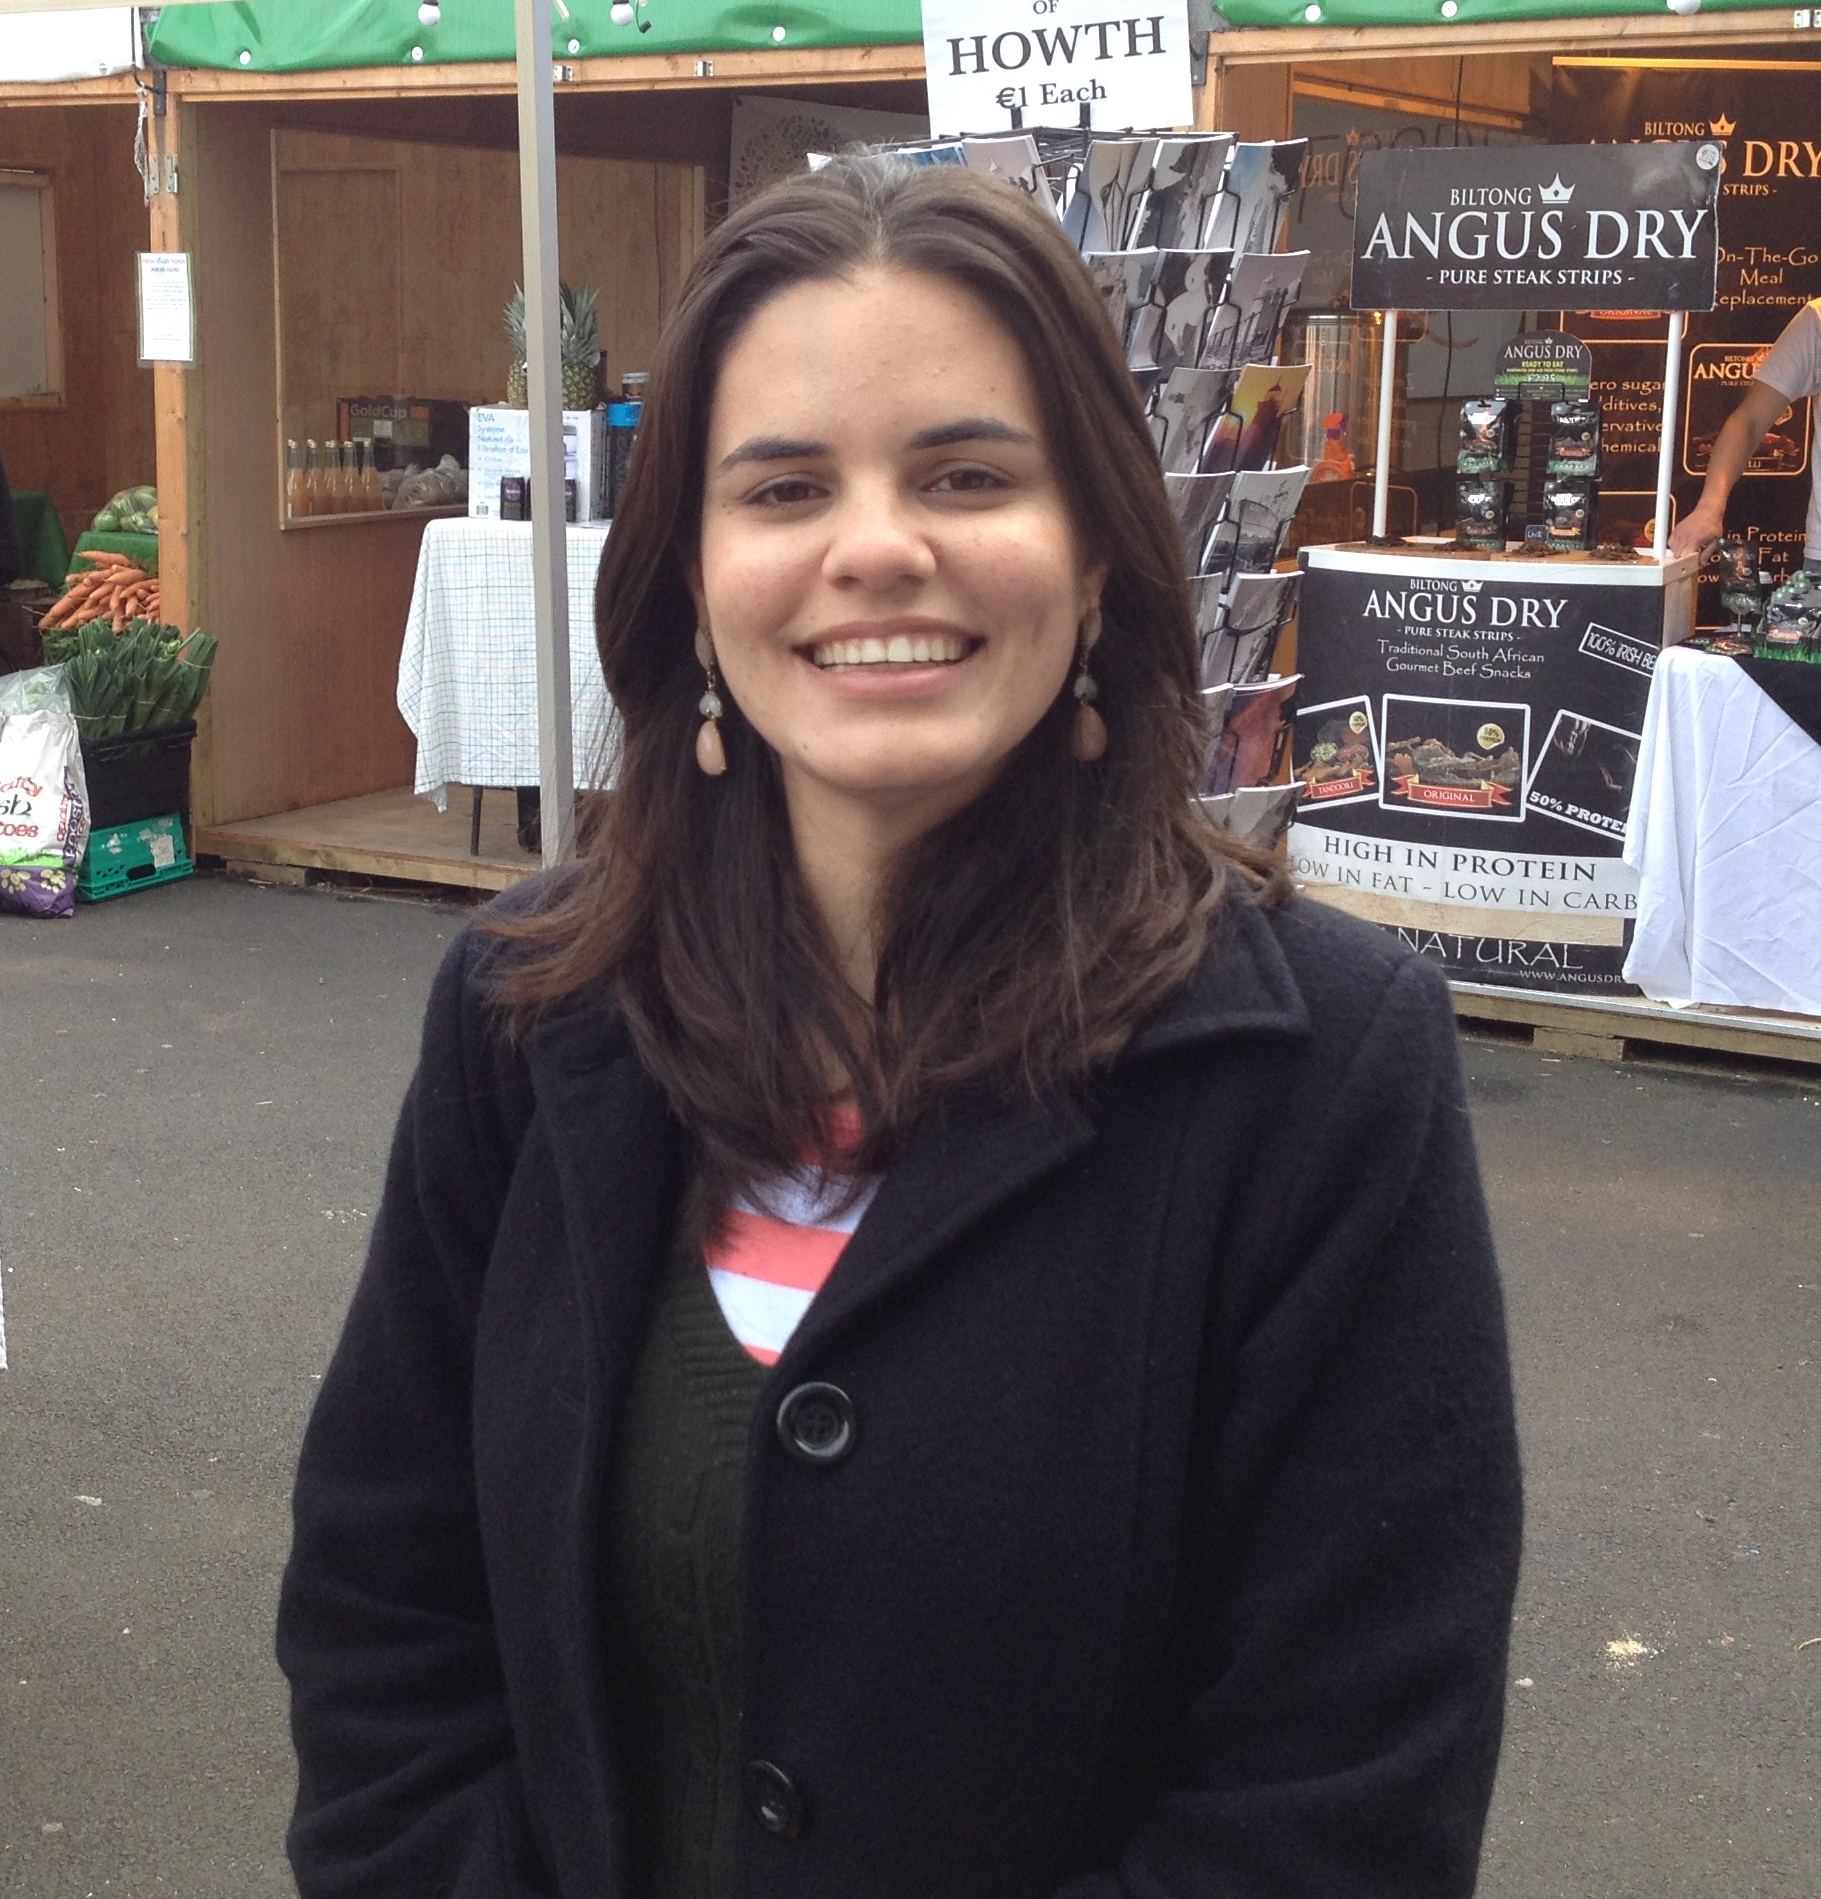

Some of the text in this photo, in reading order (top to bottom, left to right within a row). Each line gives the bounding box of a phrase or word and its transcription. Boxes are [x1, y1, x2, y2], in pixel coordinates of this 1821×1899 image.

[1032, 0, 1059, 14] OF
[947, 15, 1166, 76] HOWTH
[995, 79, 1107, 109] €1 Each
[1645, 122, 1705, 136] BILTONG
[1743, 140, 1821, 178] DRY
[1450, 187, 1532, 205] BILTONG
[1722, 184, 1769, 196] STRIPS
[1360, 209, 1709, 260] ANGUS DRY
[1439, 270, 1622, 285] PURE STEAK STRIPS
[1740, 268, 1783, 286] Meal
[1716, 289, 1813, 311] eplacement
[1504, 345, 1583, 359] ANGUS DRY
[1590, 381, 1617, 390] ero
[1602, 419, 1665, 432] ervative
[1602, 437, 1661, 452] hemical
[1758, 547, 1789, 565] Fat
[1410, 579, 1457, 592] BILTONG
[1697, 574, 1720, 584] ow
[1362, 589, 1568, 629] ANGUS DRY
[1404, 626, 1514, 642] PURE STEAK STRIPS
[1377, 638, 1545, 664] Traditional South African
[1587, 632, 1657, 670] 100% IRISH BE
[1386, 657, 1531, 680] Gourmet Beef Snacks
[1423, 790, 1476, 802] ORIGINAL
[1529, 791, 1563, 812] 50%
[1324, 835, 1597, 882] HIGH IN PROTEIN
[1338, 867, 1361, 885] IN
[1372, 872, 1413, 893] FAT
[1444, 881, 1506, 903] LOW
[1518, 889, 1549, 907] IN
[1398, 927, 1583, 969] NATURAL
[1519, 969, 1624, 983] WWW.ANGUSDR
